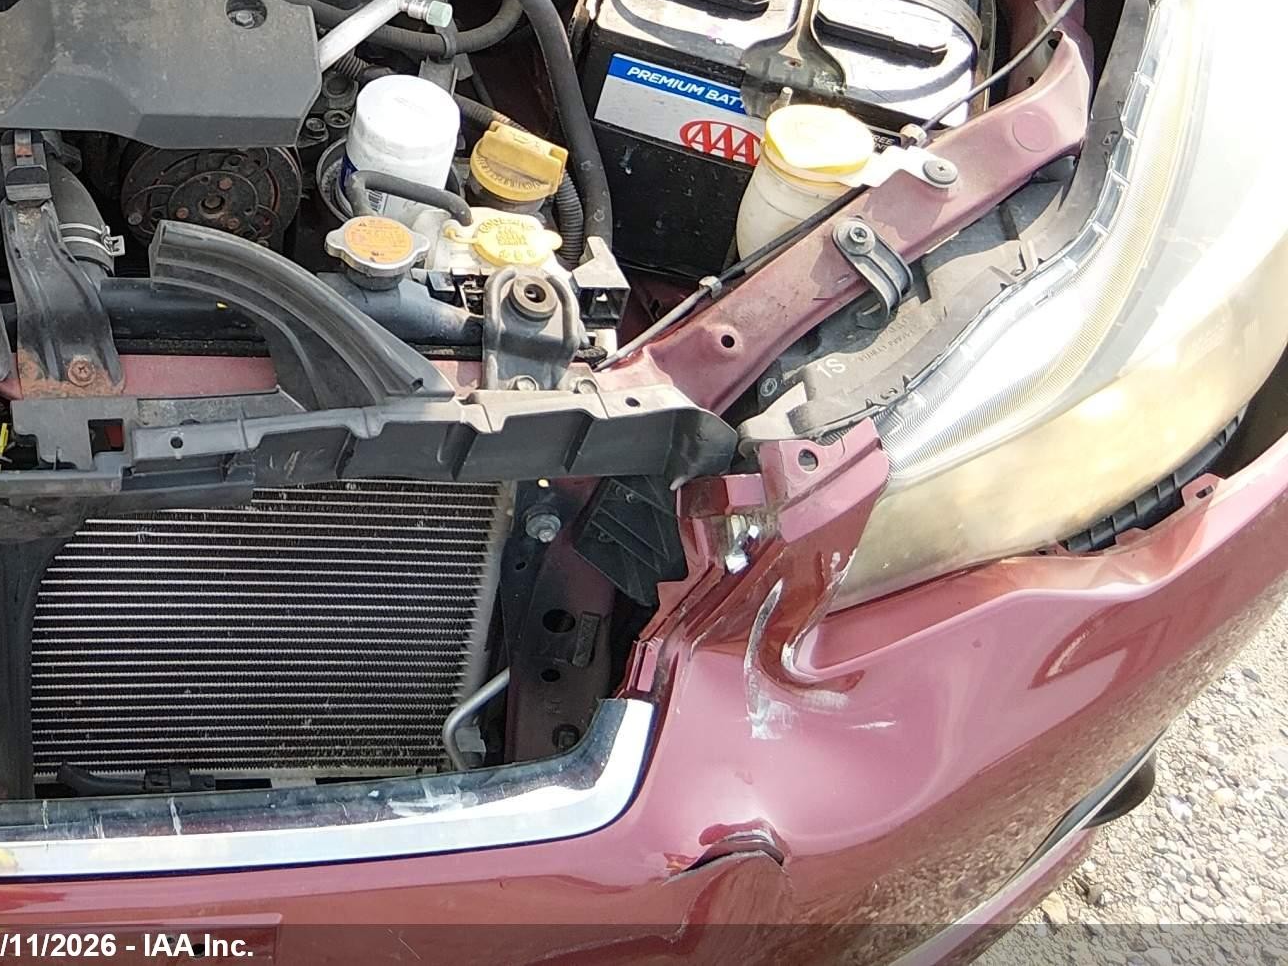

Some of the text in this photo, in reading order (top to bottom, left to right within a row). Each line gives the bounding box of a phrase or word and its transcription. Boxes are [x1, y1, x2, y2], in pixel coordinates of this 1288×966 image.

[626, 66, 706, 96] PREMIUM
[686, 121, 758, 166] AAA
[815, 358, 846, 378] 1S
